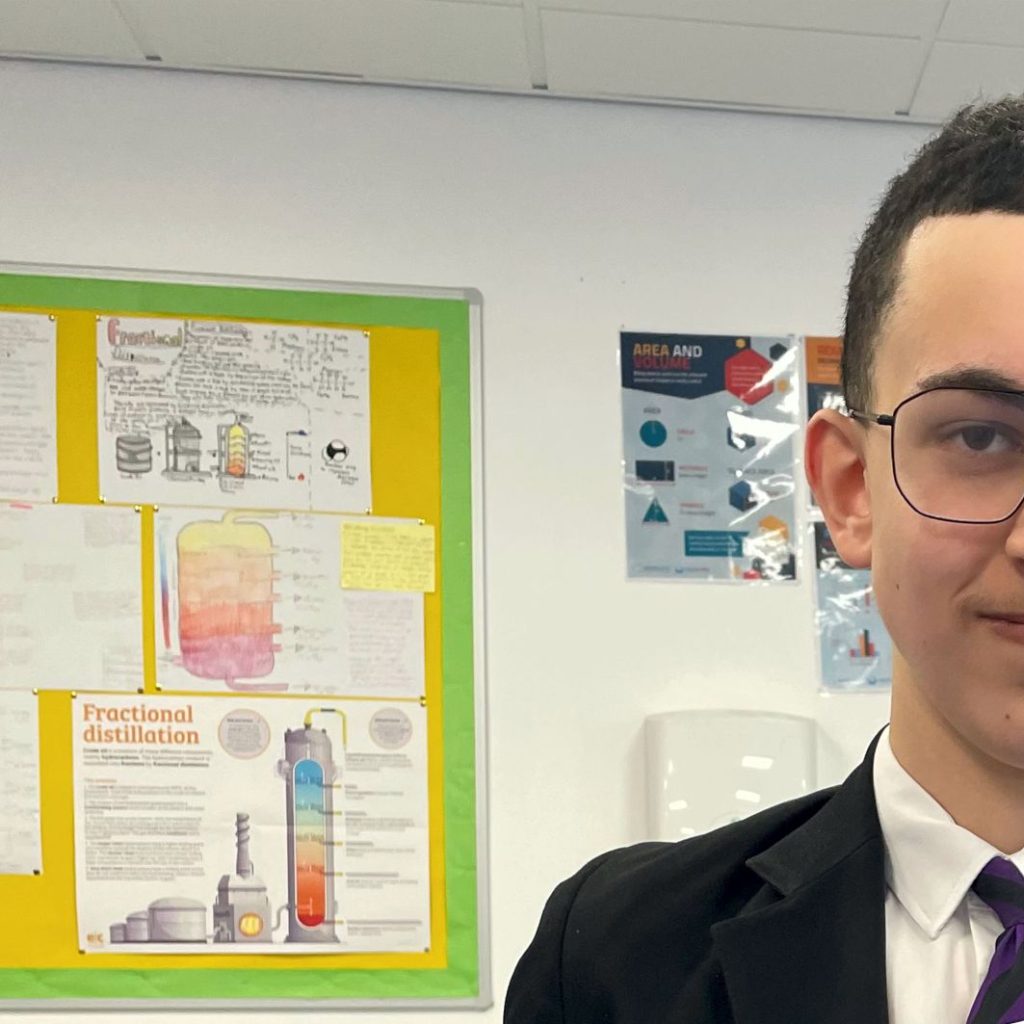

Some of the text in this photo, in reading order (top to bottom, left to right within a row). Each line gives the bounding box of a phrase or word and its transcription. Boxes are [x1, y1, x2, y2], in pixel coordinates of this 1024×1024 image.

[633, 343, 703, 358] AREA AND
[633, 356, 692, 370] VOLUME
[83, 704, 194, 723] Fractional
[83, 725, 200, 744] distillation
